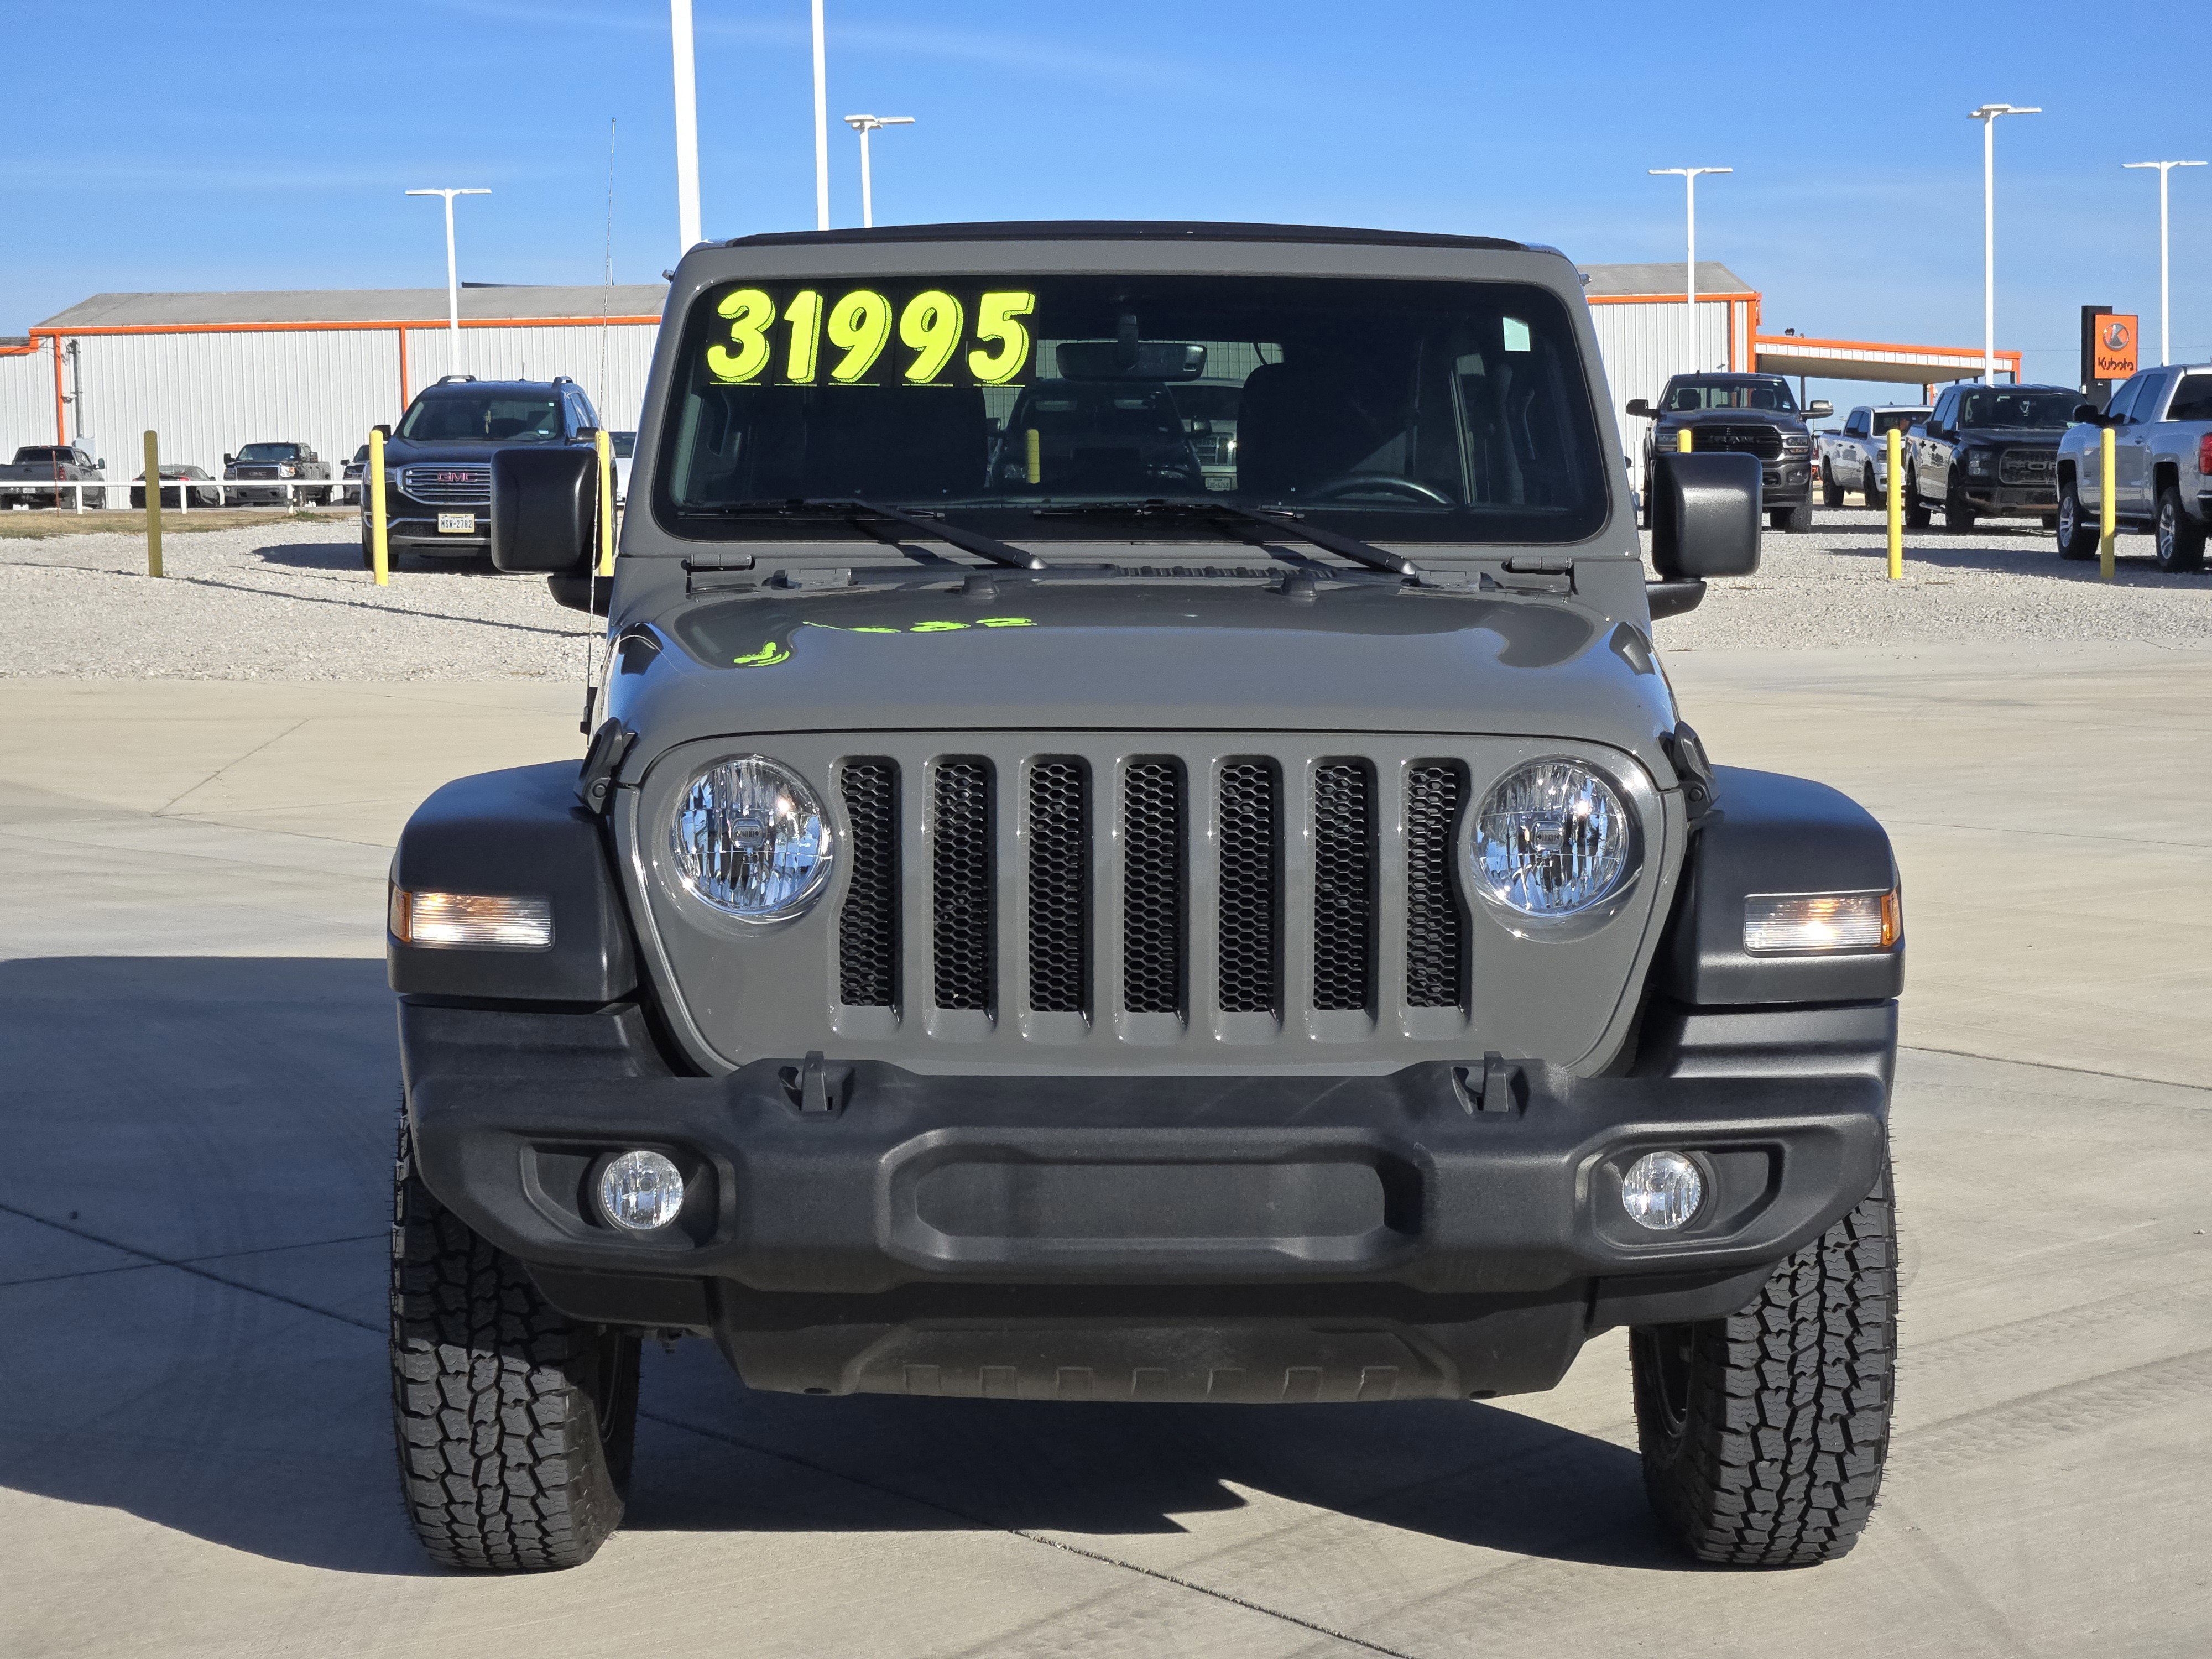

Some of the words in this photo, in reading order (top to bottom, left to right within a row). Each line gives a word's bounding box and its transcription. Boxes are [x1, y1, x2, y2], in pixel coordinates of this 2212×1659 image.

[707, 289, 1035, 383] 31995
[2098, 357, 2134, 371] Kubota
[438, 472, 477, 482] GMC
